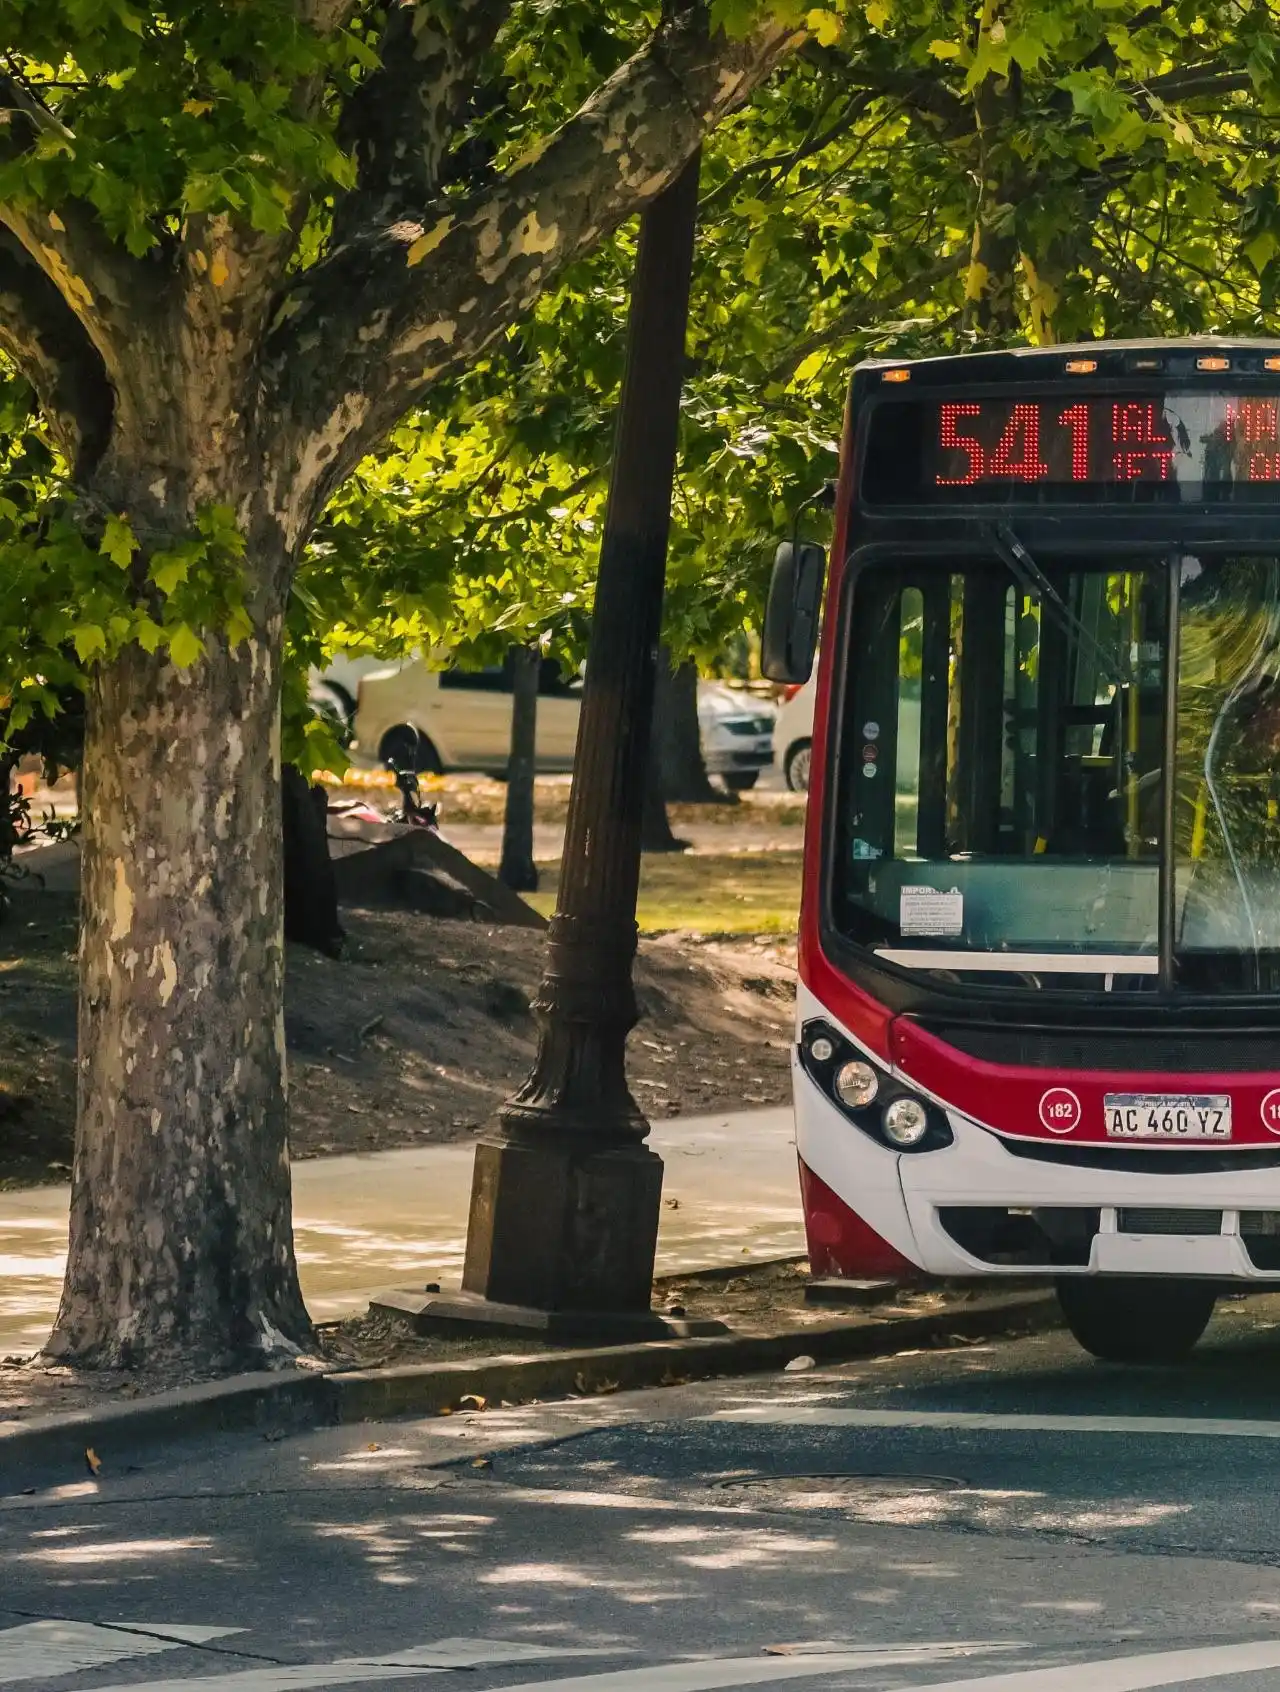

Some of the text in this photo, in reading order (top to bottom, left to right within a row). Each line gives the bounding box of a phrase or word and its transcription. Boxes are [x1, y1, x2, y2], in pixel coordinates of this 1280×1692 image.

[936, 404, 1089, 485] 541
[1047, 1103, 1073, 1118] 182
[1112, 1109, 1225, 1133] AC 460 YZ
